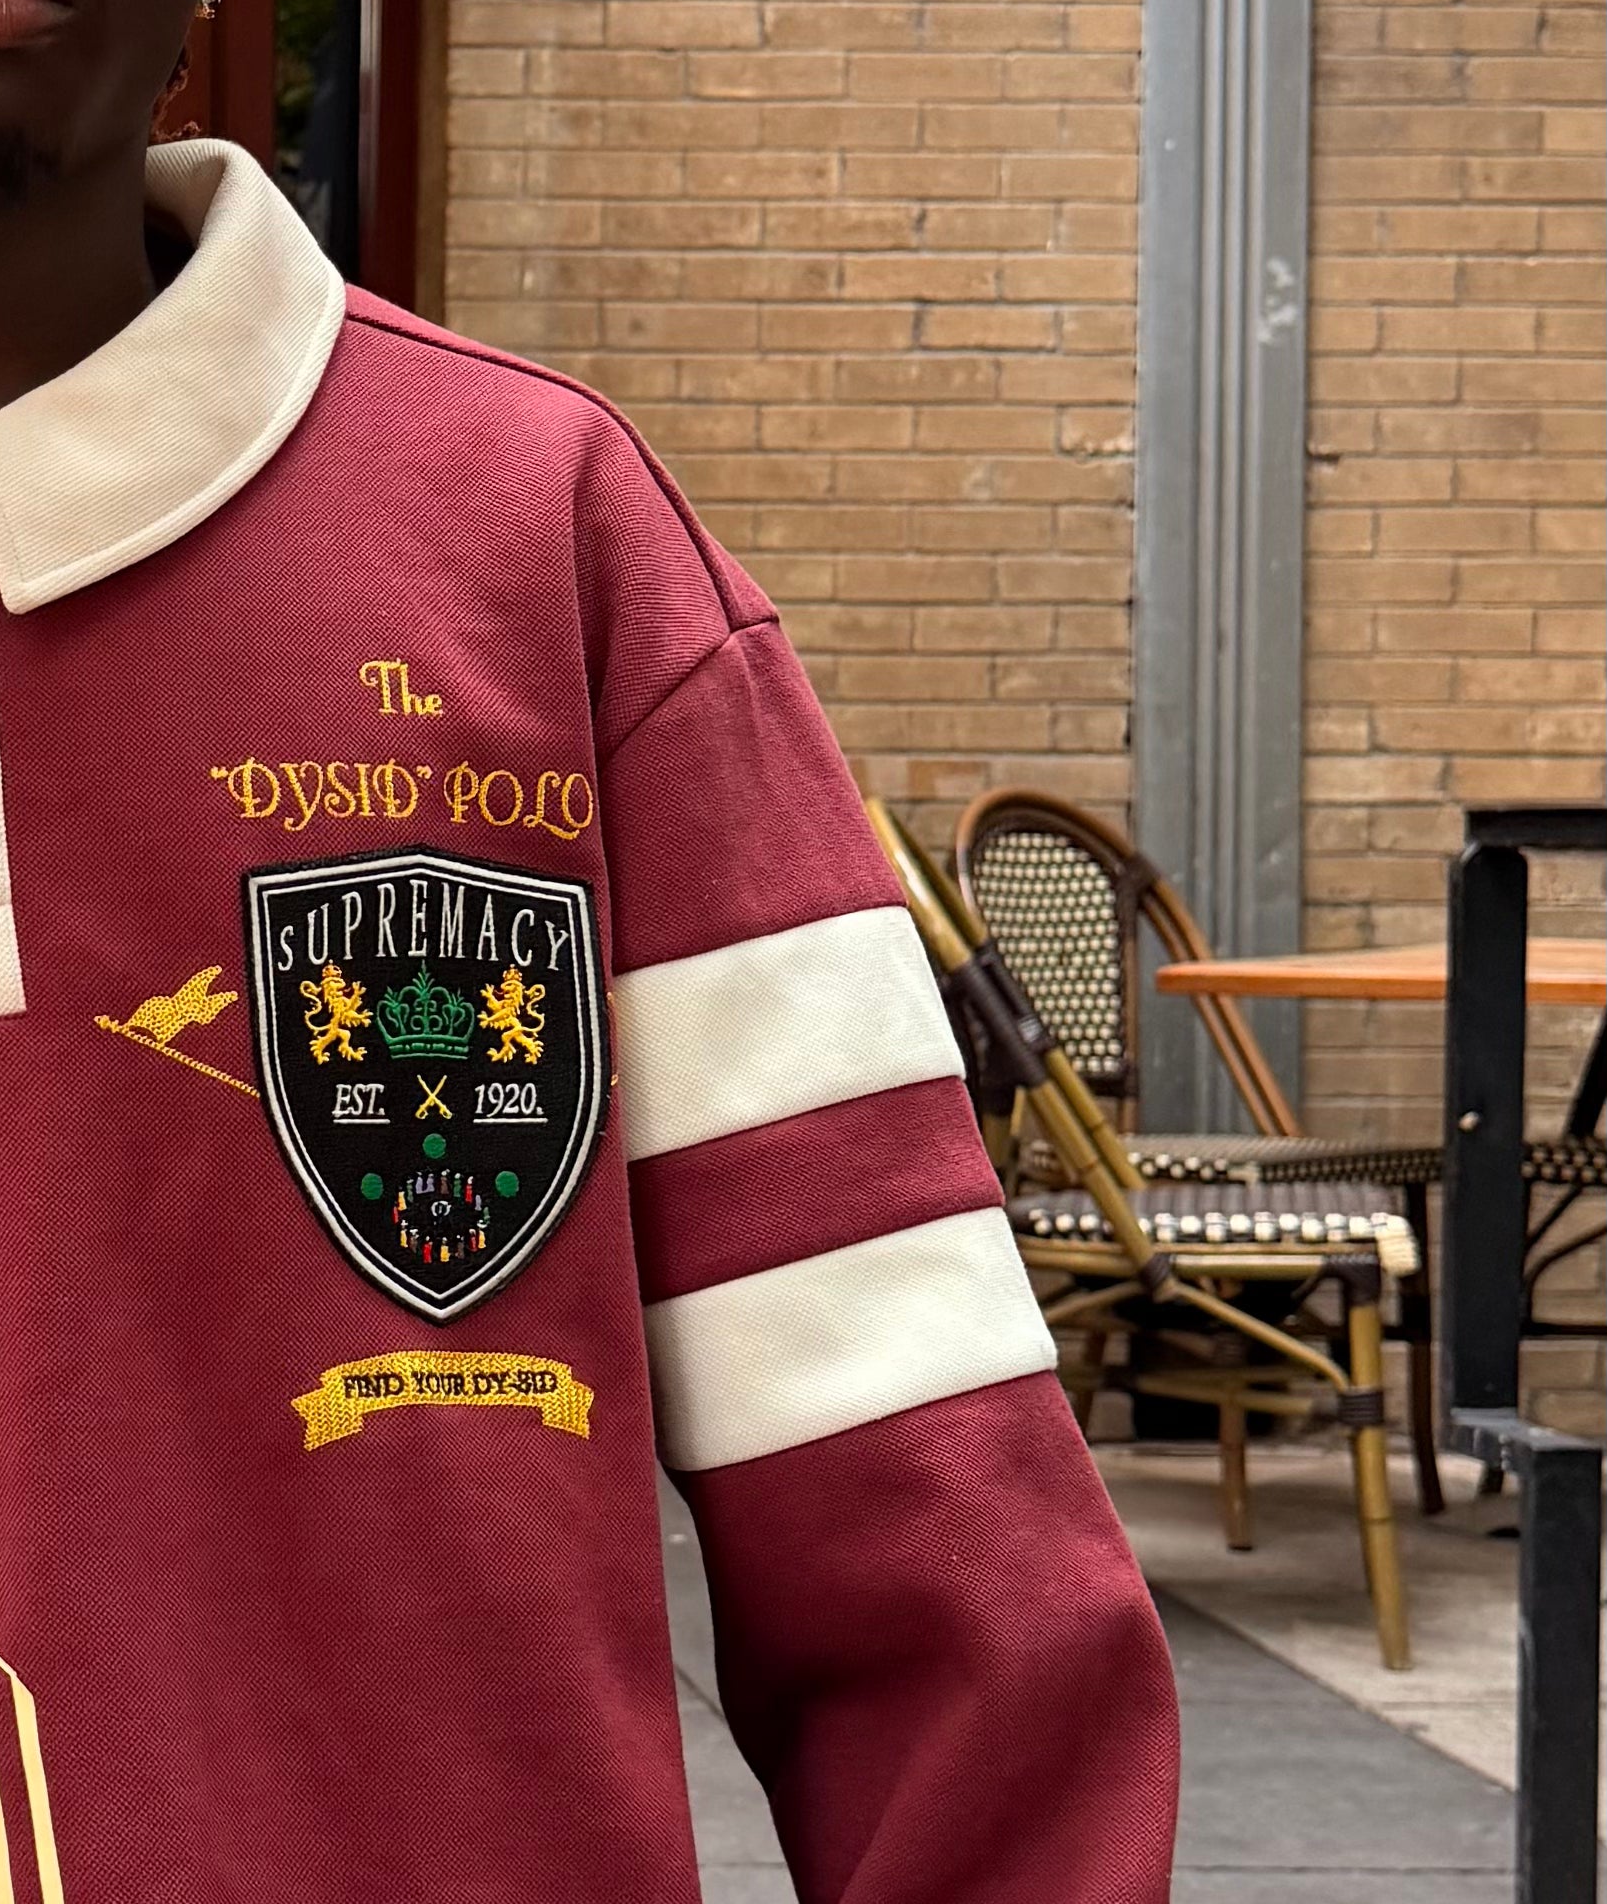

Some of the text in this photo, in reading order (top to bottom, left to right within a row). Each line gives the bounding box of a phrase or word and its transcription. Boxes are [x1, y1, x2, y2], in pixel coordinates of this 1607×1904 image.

[358, 656, 445, 717] The
[442, 760, 595, 841] POLO
[277, 878, 571, 973] SUPREMACY
[330, 1082, 545, 1117] EST. 1920.
[344, 1371, 406, 1399] FIND
[410, 1369, 470, 1397] YOUR
